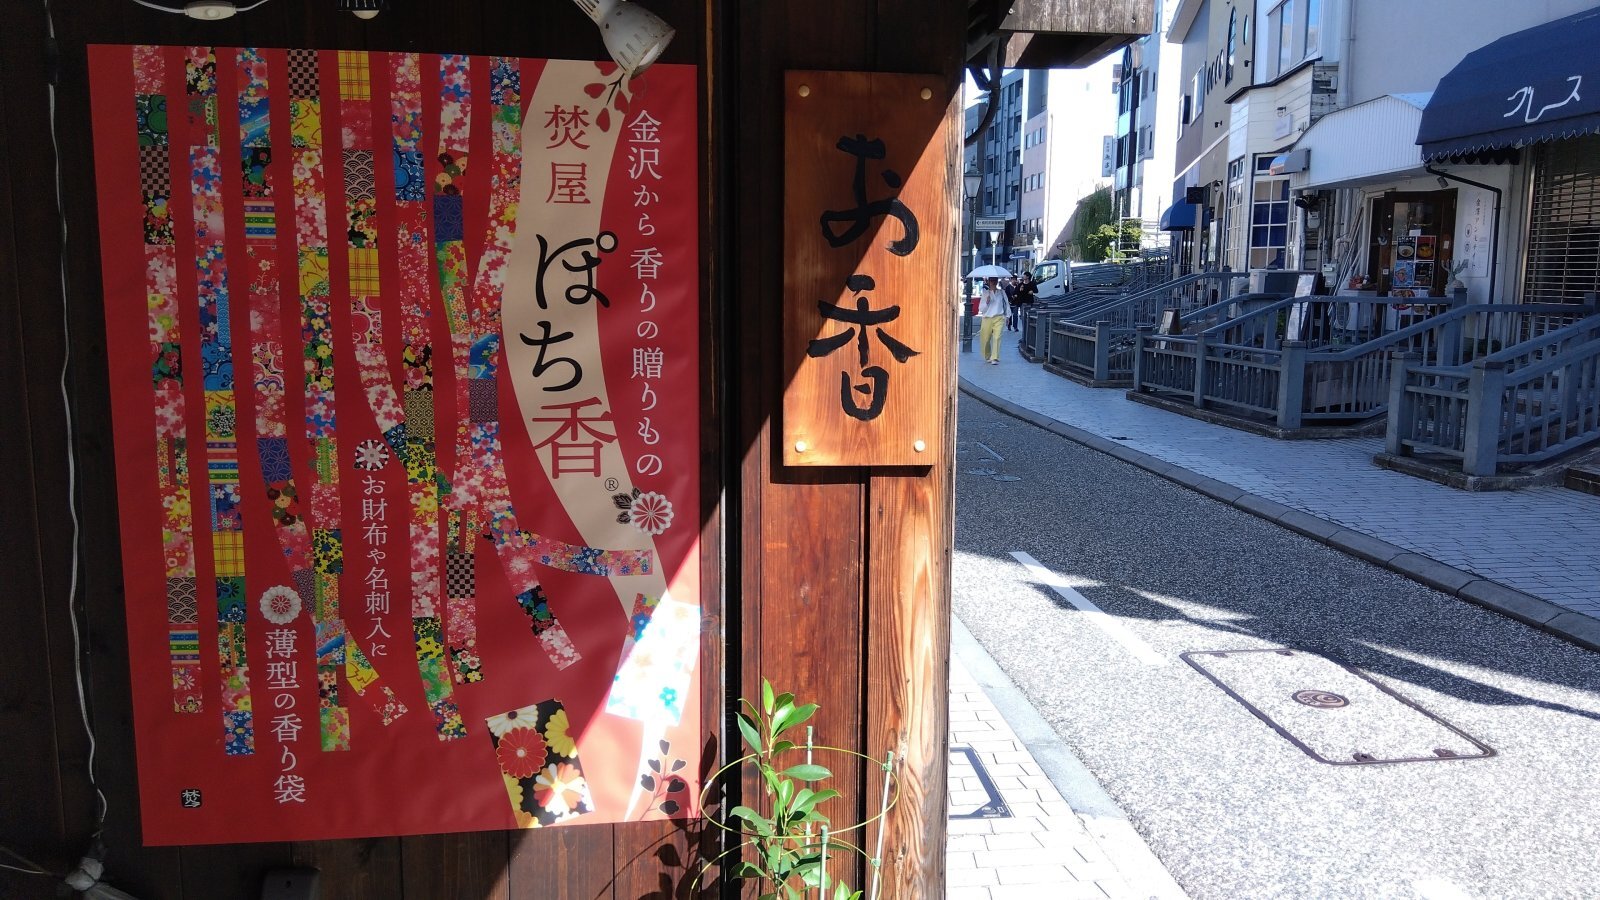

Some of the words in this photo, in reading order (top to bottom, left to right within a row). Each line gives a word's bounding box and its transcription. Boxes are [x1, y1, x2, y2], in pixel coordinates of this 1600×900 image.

[519, 230, 619, 480] ぽち香
[627, 109, 664, 477] 金沢から香りの贈りもの
[806, 133, 922, 421] お香
[361, 475, 392, 657] お財布や名刺入に
[264, 628, 306, 804] 薄型の香り袋
